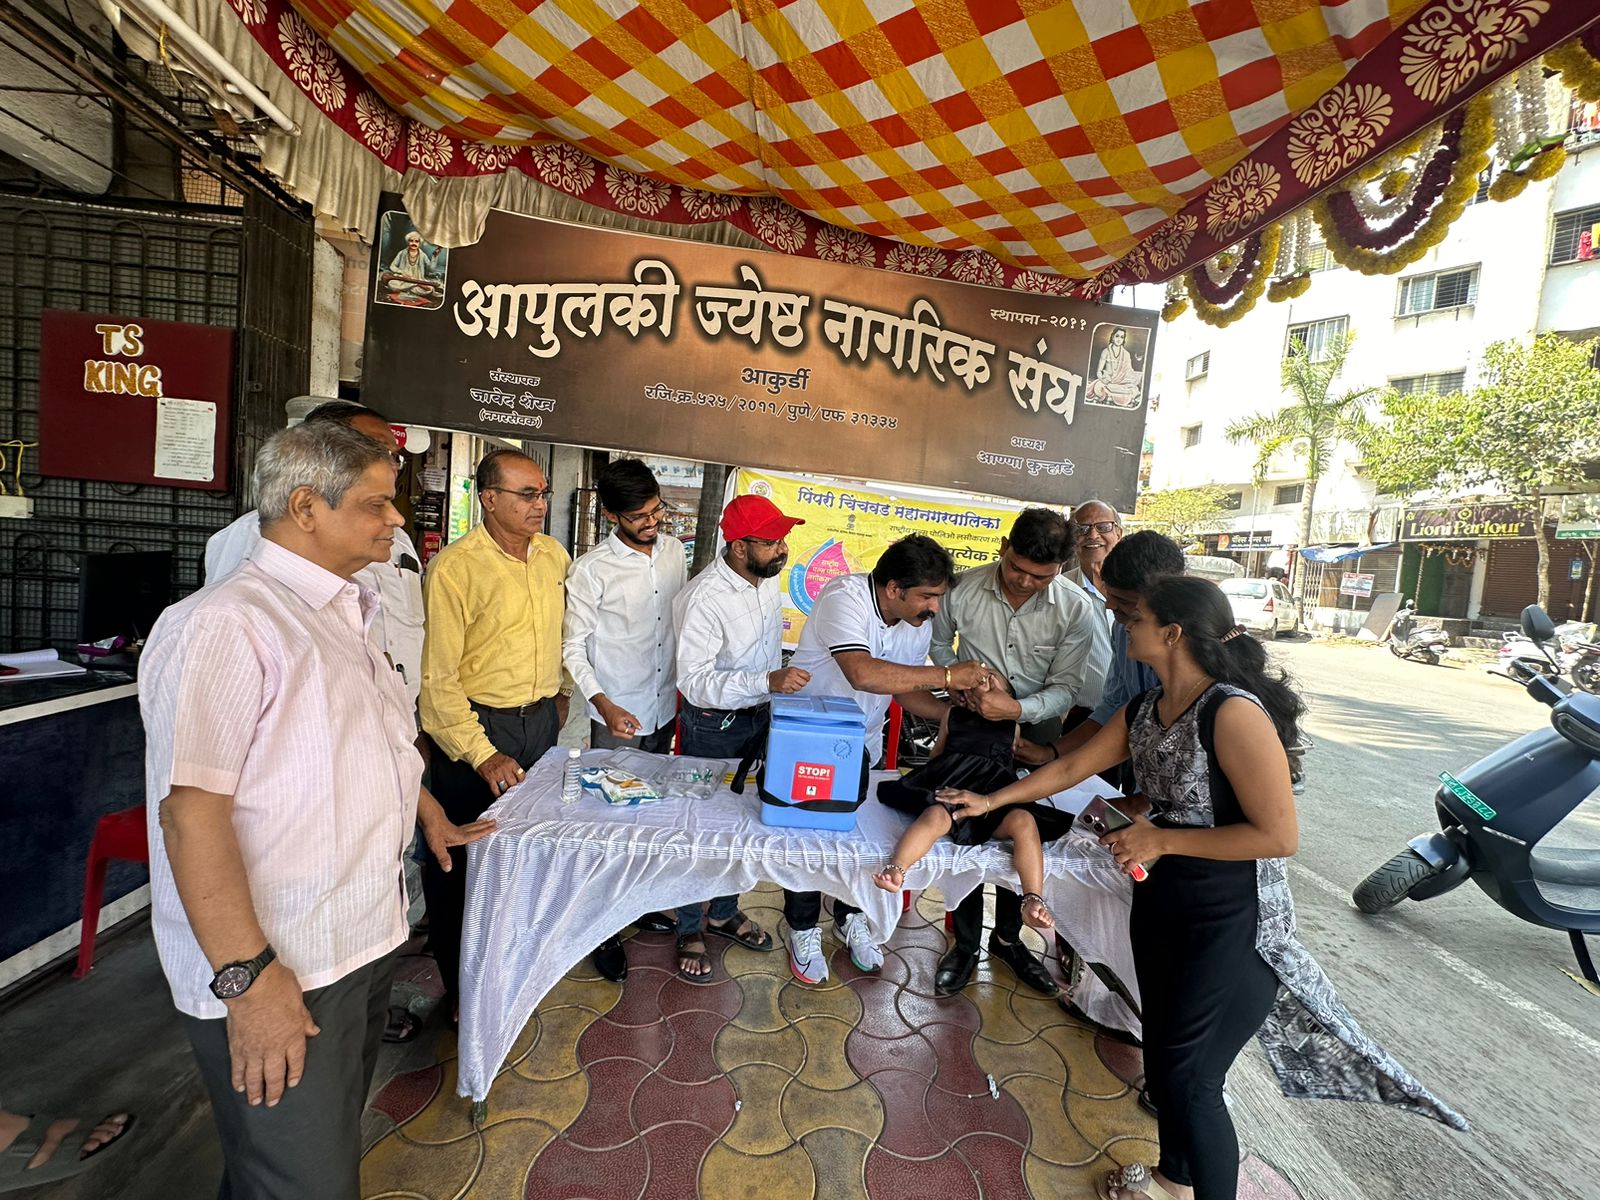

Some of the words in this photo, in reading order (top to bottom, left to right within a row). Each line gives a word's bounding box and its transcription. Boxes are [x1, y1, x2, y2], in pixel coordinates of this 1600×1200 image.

[989, 307, 1088, 331] स्थापना-२०११
[95, 324, 144, 357] TS
[453, 260, 680, 358] आपुलकी
[695, 265, 810, 348] ज्येष्ठ
[823, 299, 996, 390] नागरिक
[1008, 337, 1082, 425] संघ
[84, 359, 163, 398] KING
[489, 367, 541, 387] संस्थापक
[741, 366, 811, 394] आकुर्डी
[470, 387, 516, 409] जावेद
[519, 391, 556, 412] शेख
[479, 408, 543, 429] (नगरसेवक)
[850, 411, 899, 429] ३१३३४
[1010, 436, 1046, 451] अध्यक्ष
[976, 450, 1024, 470] आण्णा
[798, 487, 835, 507] पिंपरी
[838, 493, 890, 516] चिंचवड
[895, 505, 1001, 530] महानगरपालिका
[798, 766, 831, 777] STOP!
